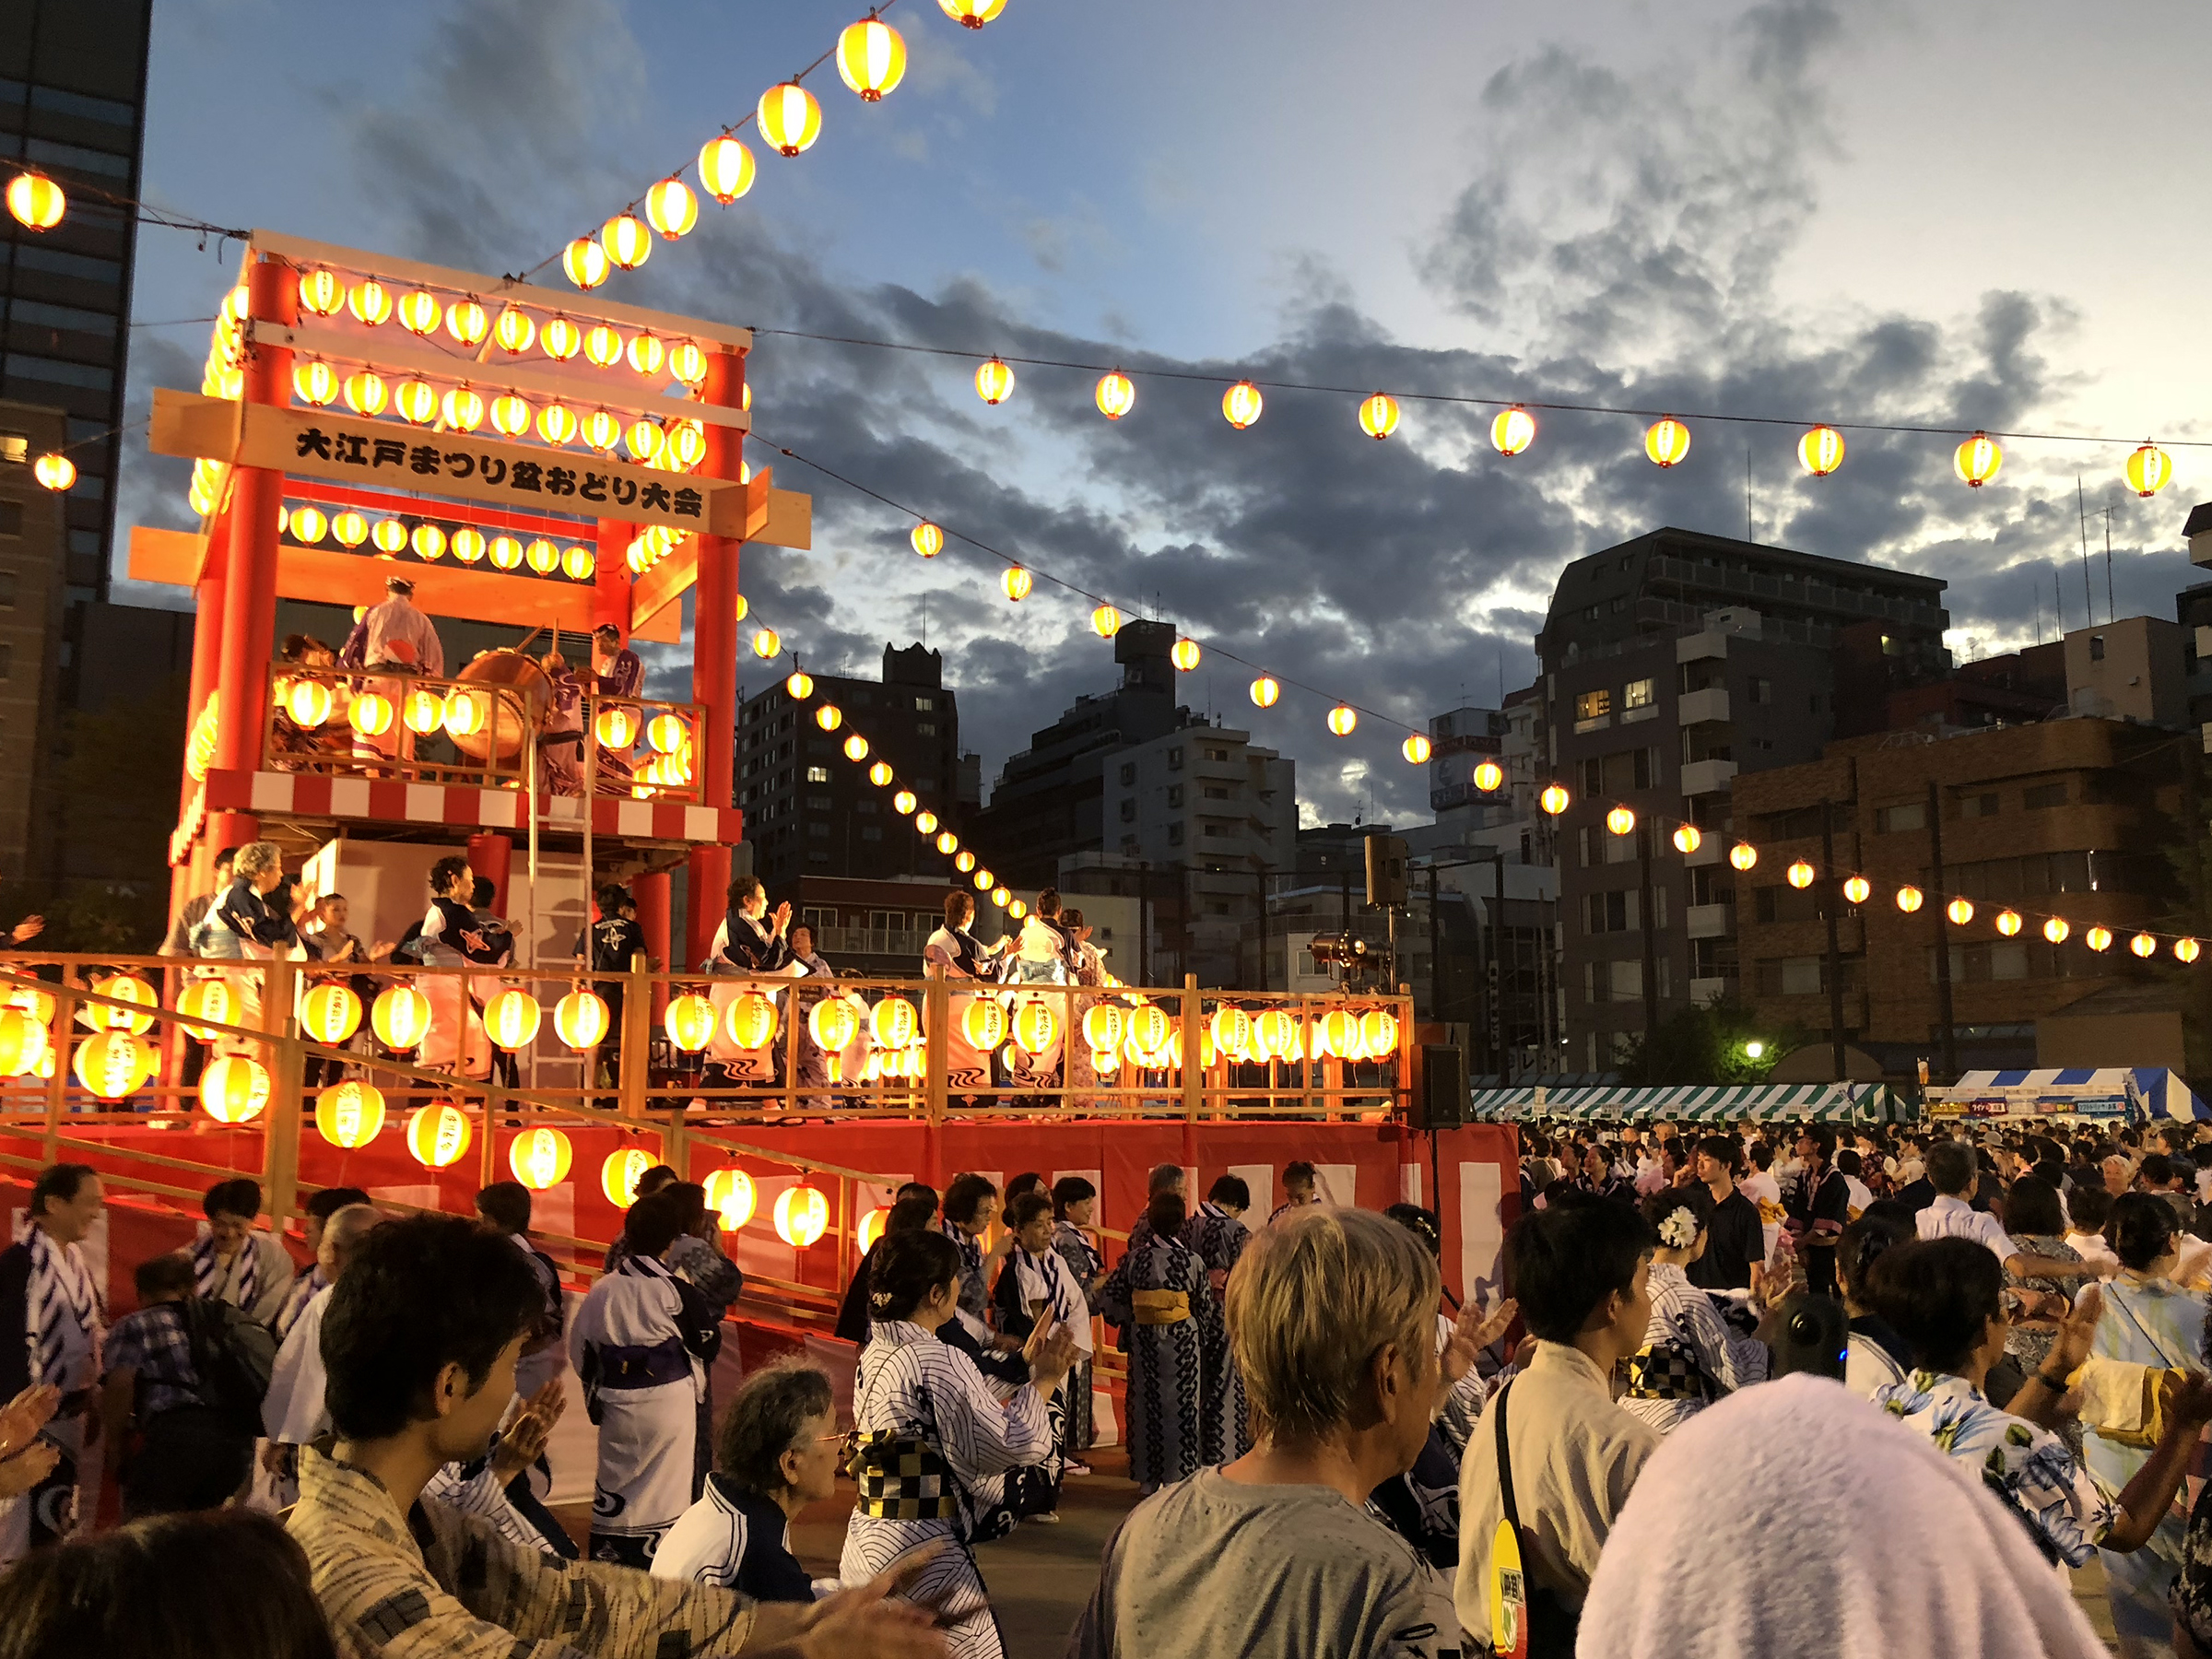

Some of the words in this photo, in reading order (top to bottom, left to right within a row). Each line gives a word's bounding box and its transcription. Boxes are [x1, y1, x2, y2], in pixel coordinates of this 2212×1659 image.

[297, 428, 704, 518] 大江戸まつり盆おどり大会
